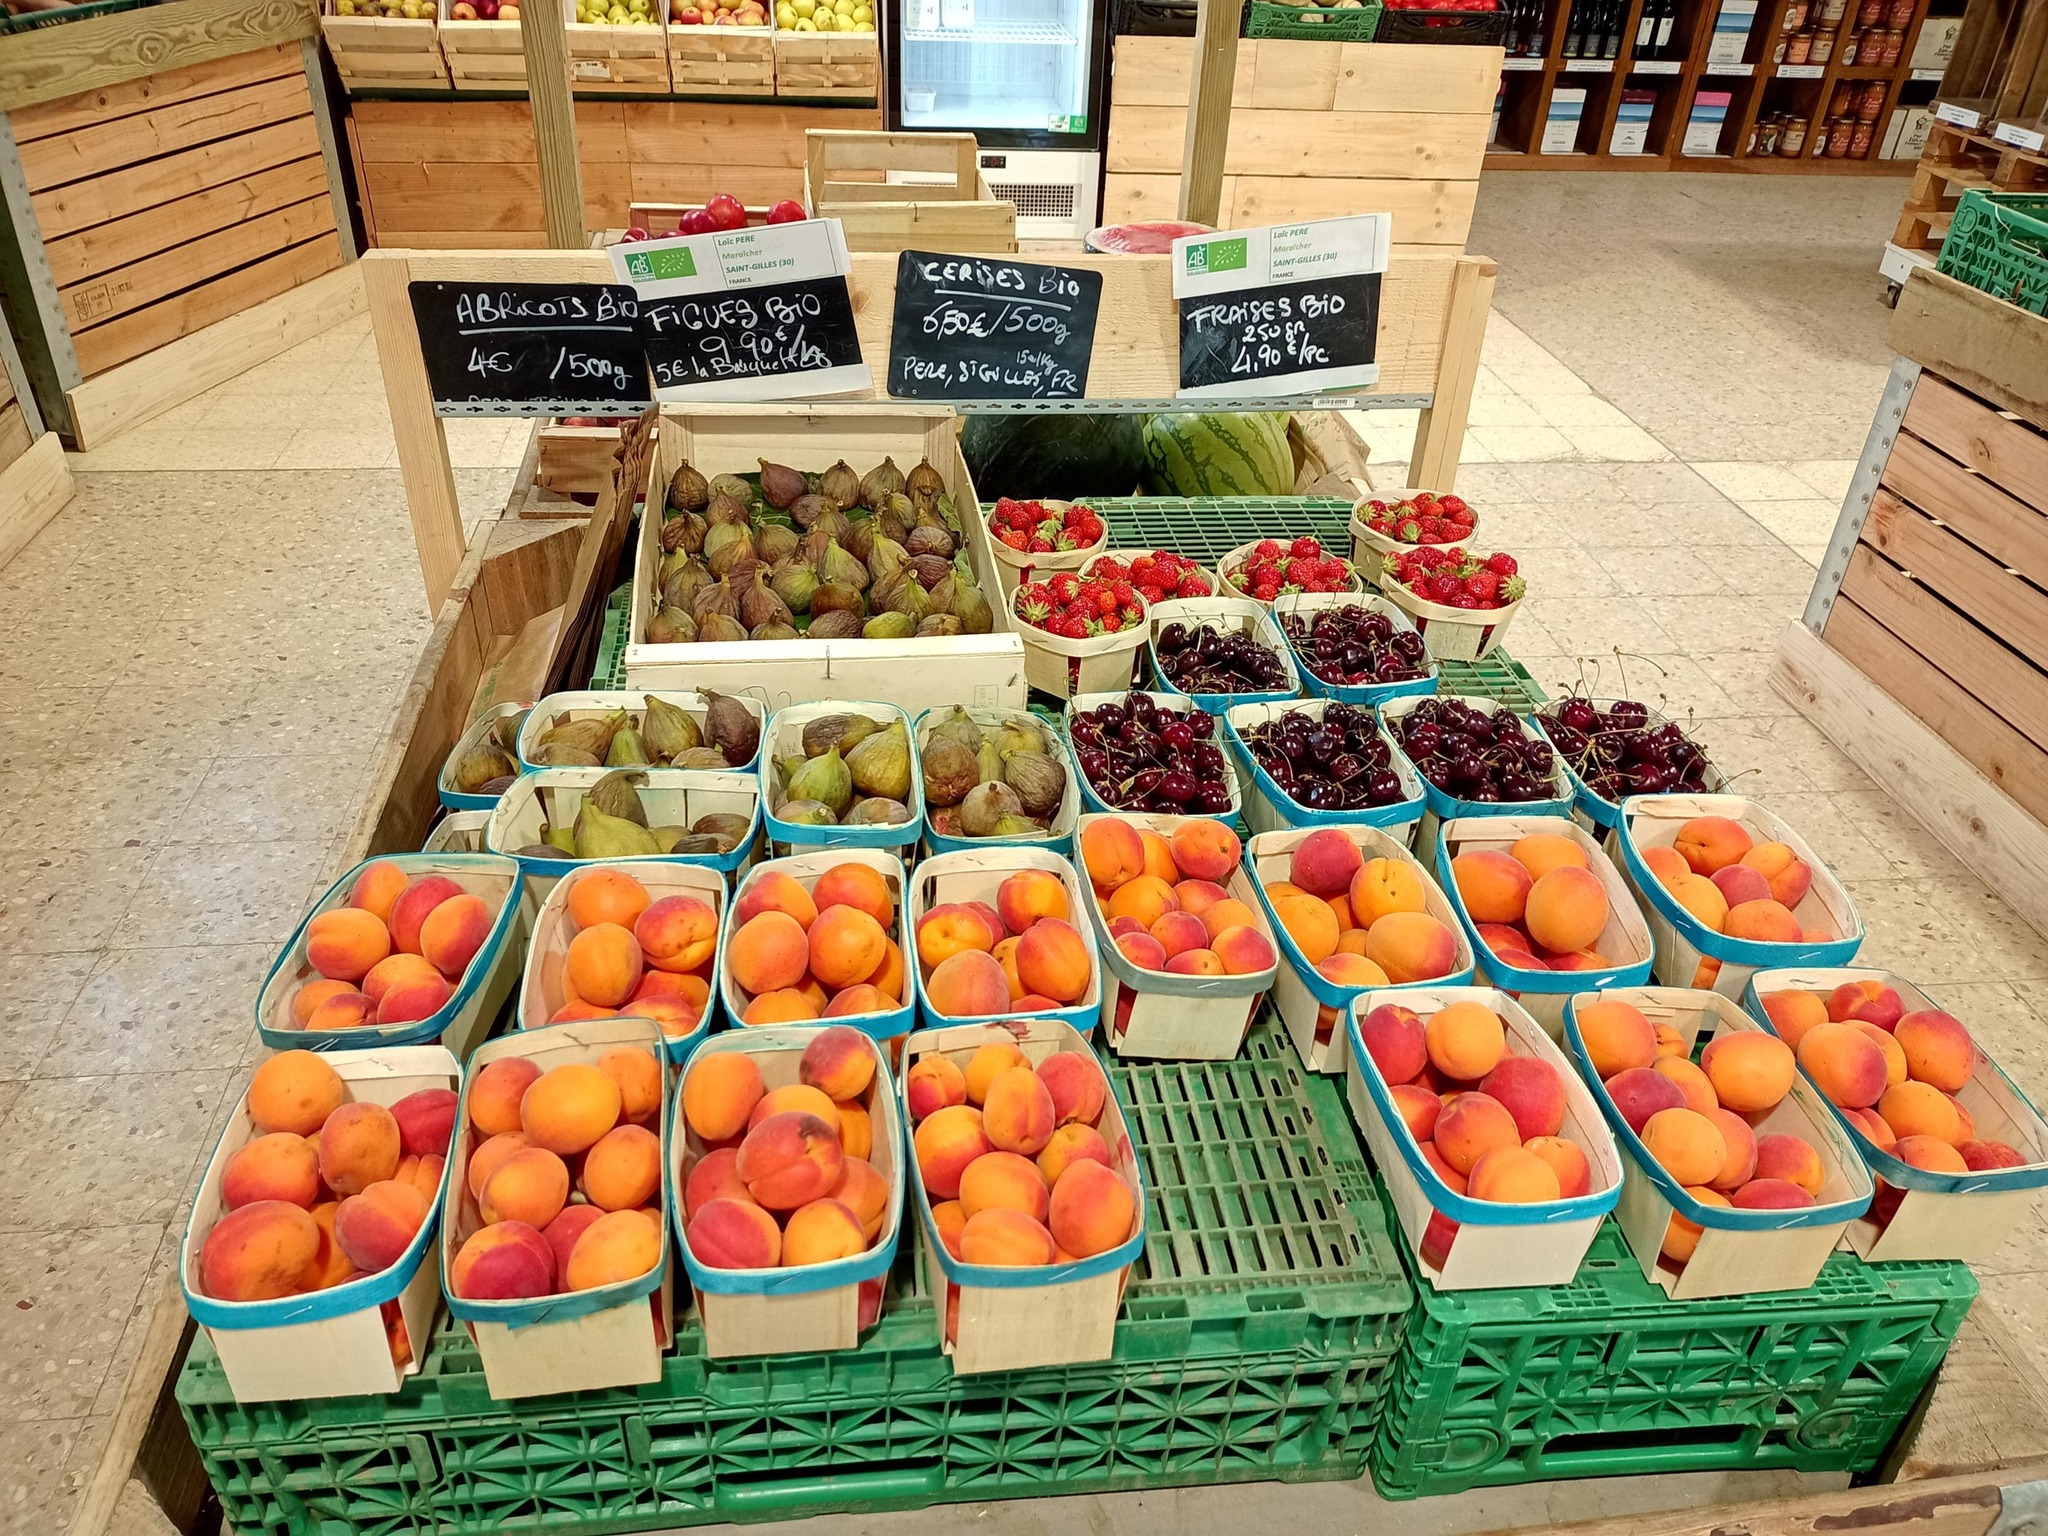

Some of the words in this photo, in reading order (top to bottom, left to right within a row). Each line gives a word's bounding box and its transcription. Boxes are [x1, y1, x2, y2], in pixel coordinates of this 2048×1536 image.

[1290, 227, 1309, 236] PERE
[718, 238, 734, 247] Loïc
[735, 234, 755, 244] PERE
[725, 260, 777, 273] SAINT-GILLES
[779, 257, 795, 268] (30)
[1272, 254, 1321, 268] SAINT-GILLES
[1322, 251, 1338, 262] (30)
[1272, 271, 1294, 279] FRANCE
[1242, 323, 1281, 342] 250
[467, 347, 512, 378] 4€
[656, 361, 688, 382] 5€
[691, 356, 710, 378] la
[1050, 369, 1078, 393] FR
